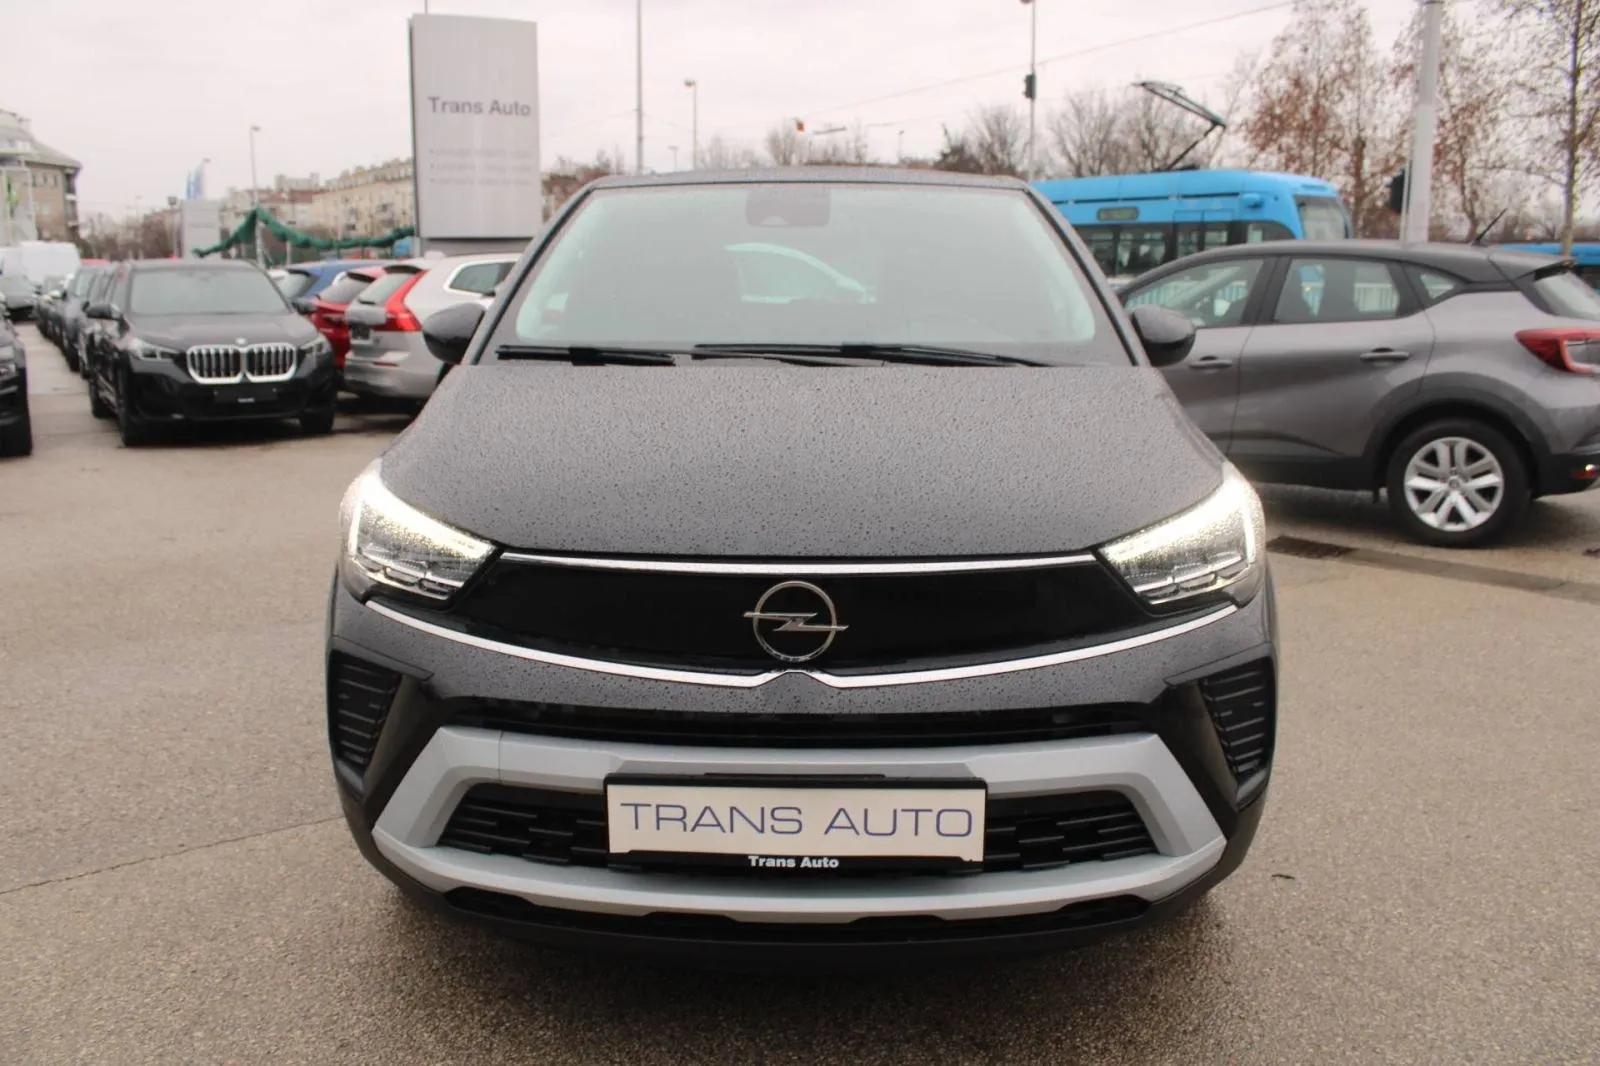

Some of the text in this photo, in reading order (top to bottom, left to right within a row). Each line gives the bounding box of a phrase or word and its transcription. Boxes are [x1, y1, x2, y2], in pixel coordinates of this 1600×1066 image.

[427, 96, 531, 117] Trans Auto
[620, 803, 973, 838] TRANS AUTO
[748, 855, 839, 869] Trans Auto
